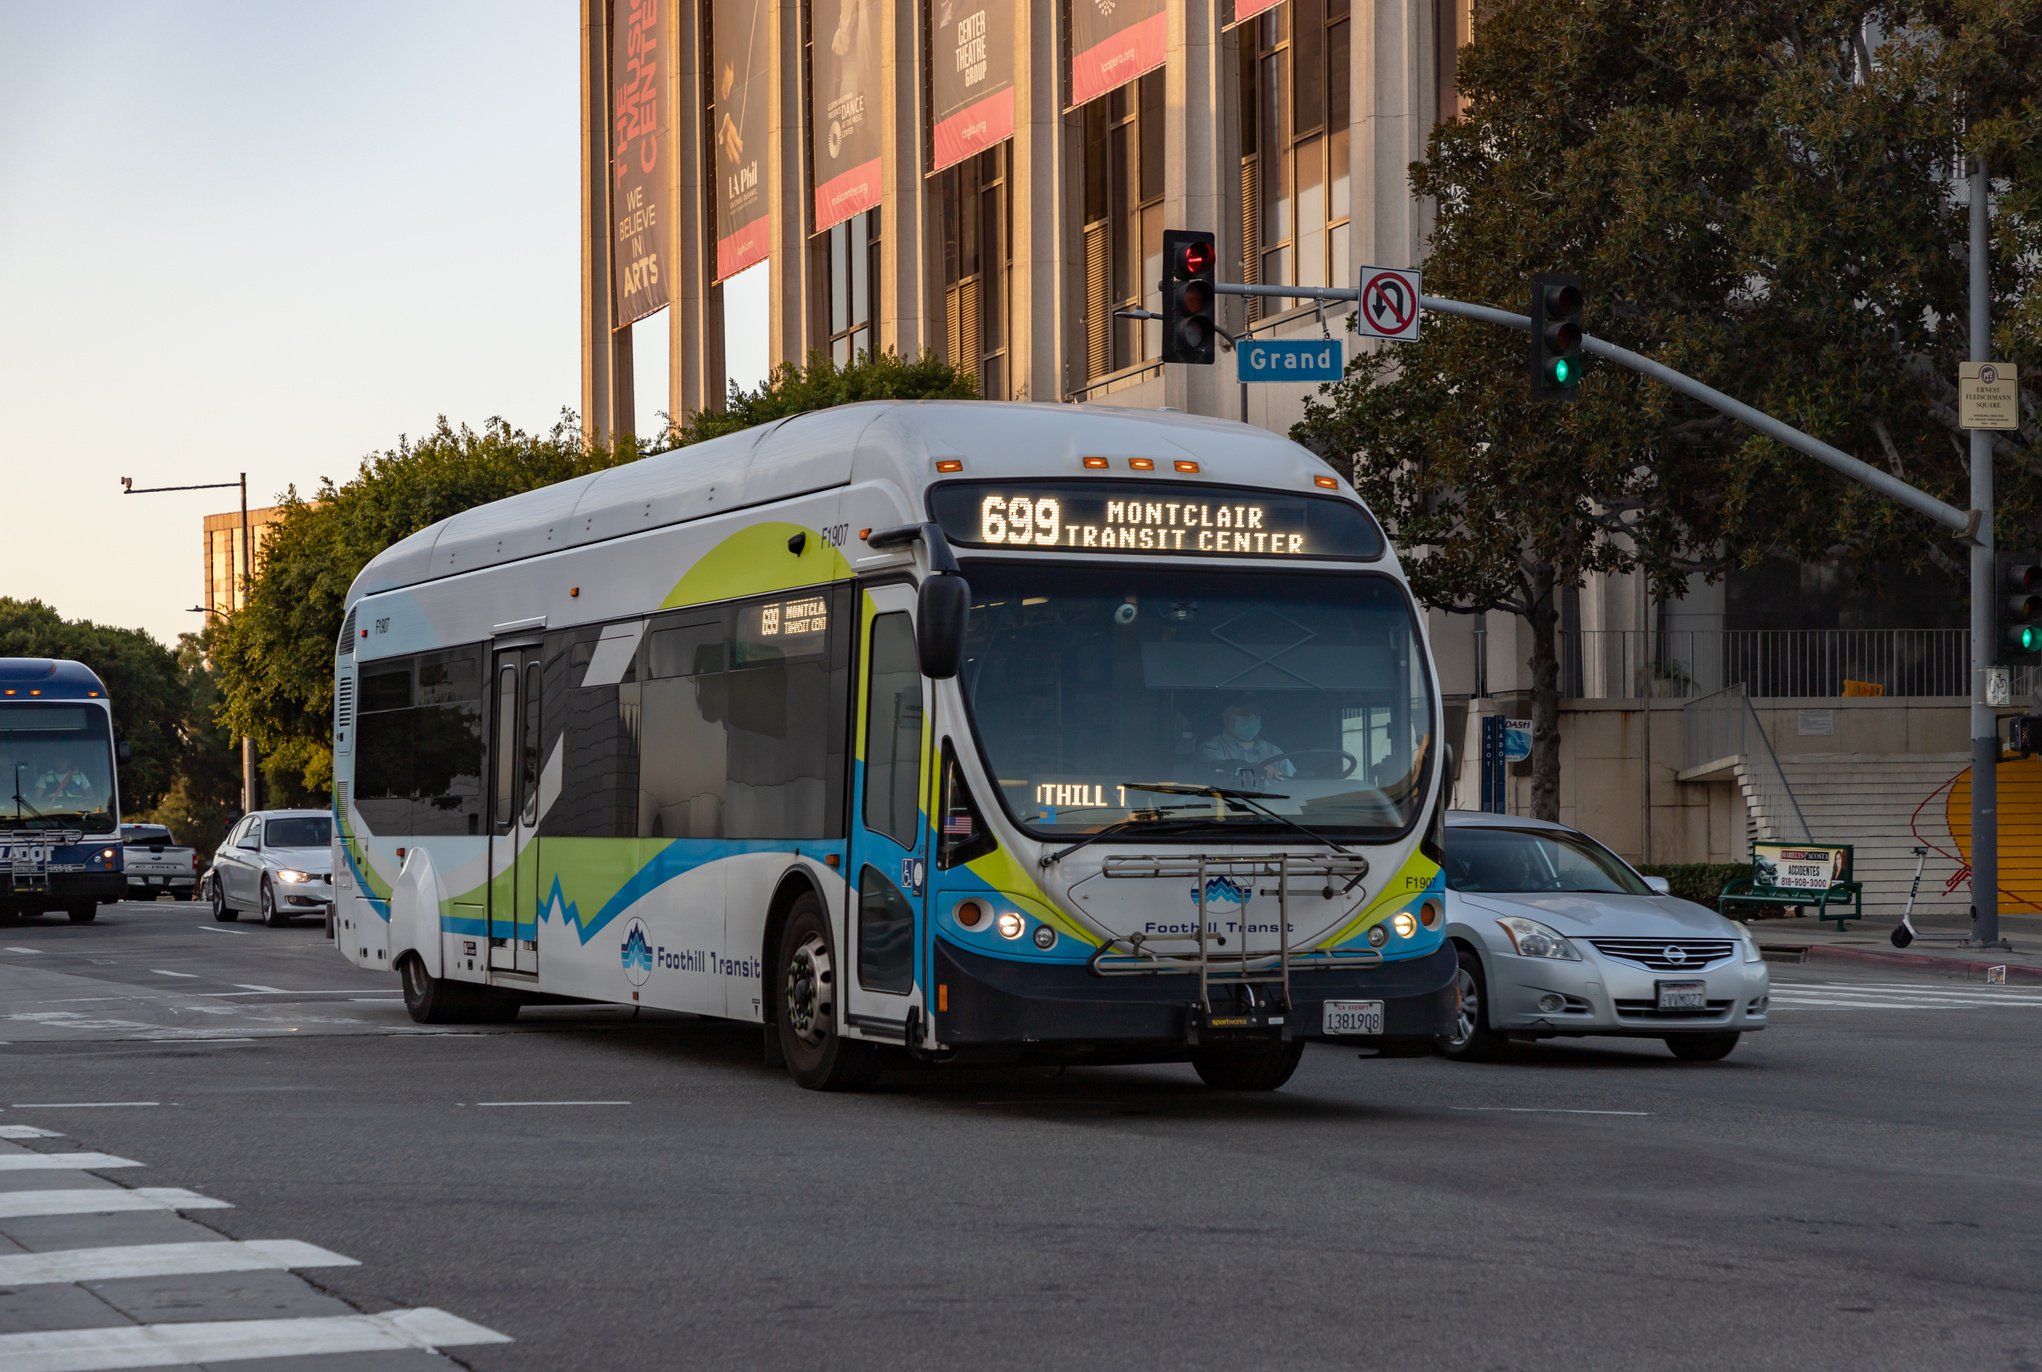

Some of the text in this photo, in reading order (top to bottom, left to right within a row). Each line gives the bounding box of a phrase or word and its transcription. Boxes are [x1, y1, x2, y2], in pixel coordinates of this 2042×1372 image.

[958, 9, 986, 46] CENTER
[955, 35, 986, 72] THEATRE
[627, 0, 642, 141] MUSI
[965, 60, 987, 87] GROUP
[640, 0, 657, 173] CENTE
[841, 95, 864, 120] DANCE
[616, 83, 628, 190] THE
[728, 159, 758, 199] LA Phil
[626, 186, 643, 212] WE
[619, 204, 656, 242] BELIEVE
[631, 235, 643, 259] IN
[624, 253, 659, 298] ARTS
[1250, 347, 1331, 370] Grand
[981, 496, 1060, 545] 699
[1107, 500, 1263, 529] MONTCLAIR
[821, 523, 849, 549] F1907
[1065, 525, 1303, 554] TRANSIT CENTER
[375, 617, 390, 635] F1907
[1505, 720, 1531, 729] DASH
[1036, 783, 1108, 807] THILL
[1807, 852, 1829, 860] ACOSTA
[1406, 876, 1437, 889] F1907
[1788, 865, 1820, 877] ACCIDENTES
[1145, 922, 1294, 933] Foothll Transt
[657, 946, 760, 979] Foothill Transit
[1212, 1017, 1248, 1026] sportworks
[1326, 1013, 1380, 1030] 1381908
